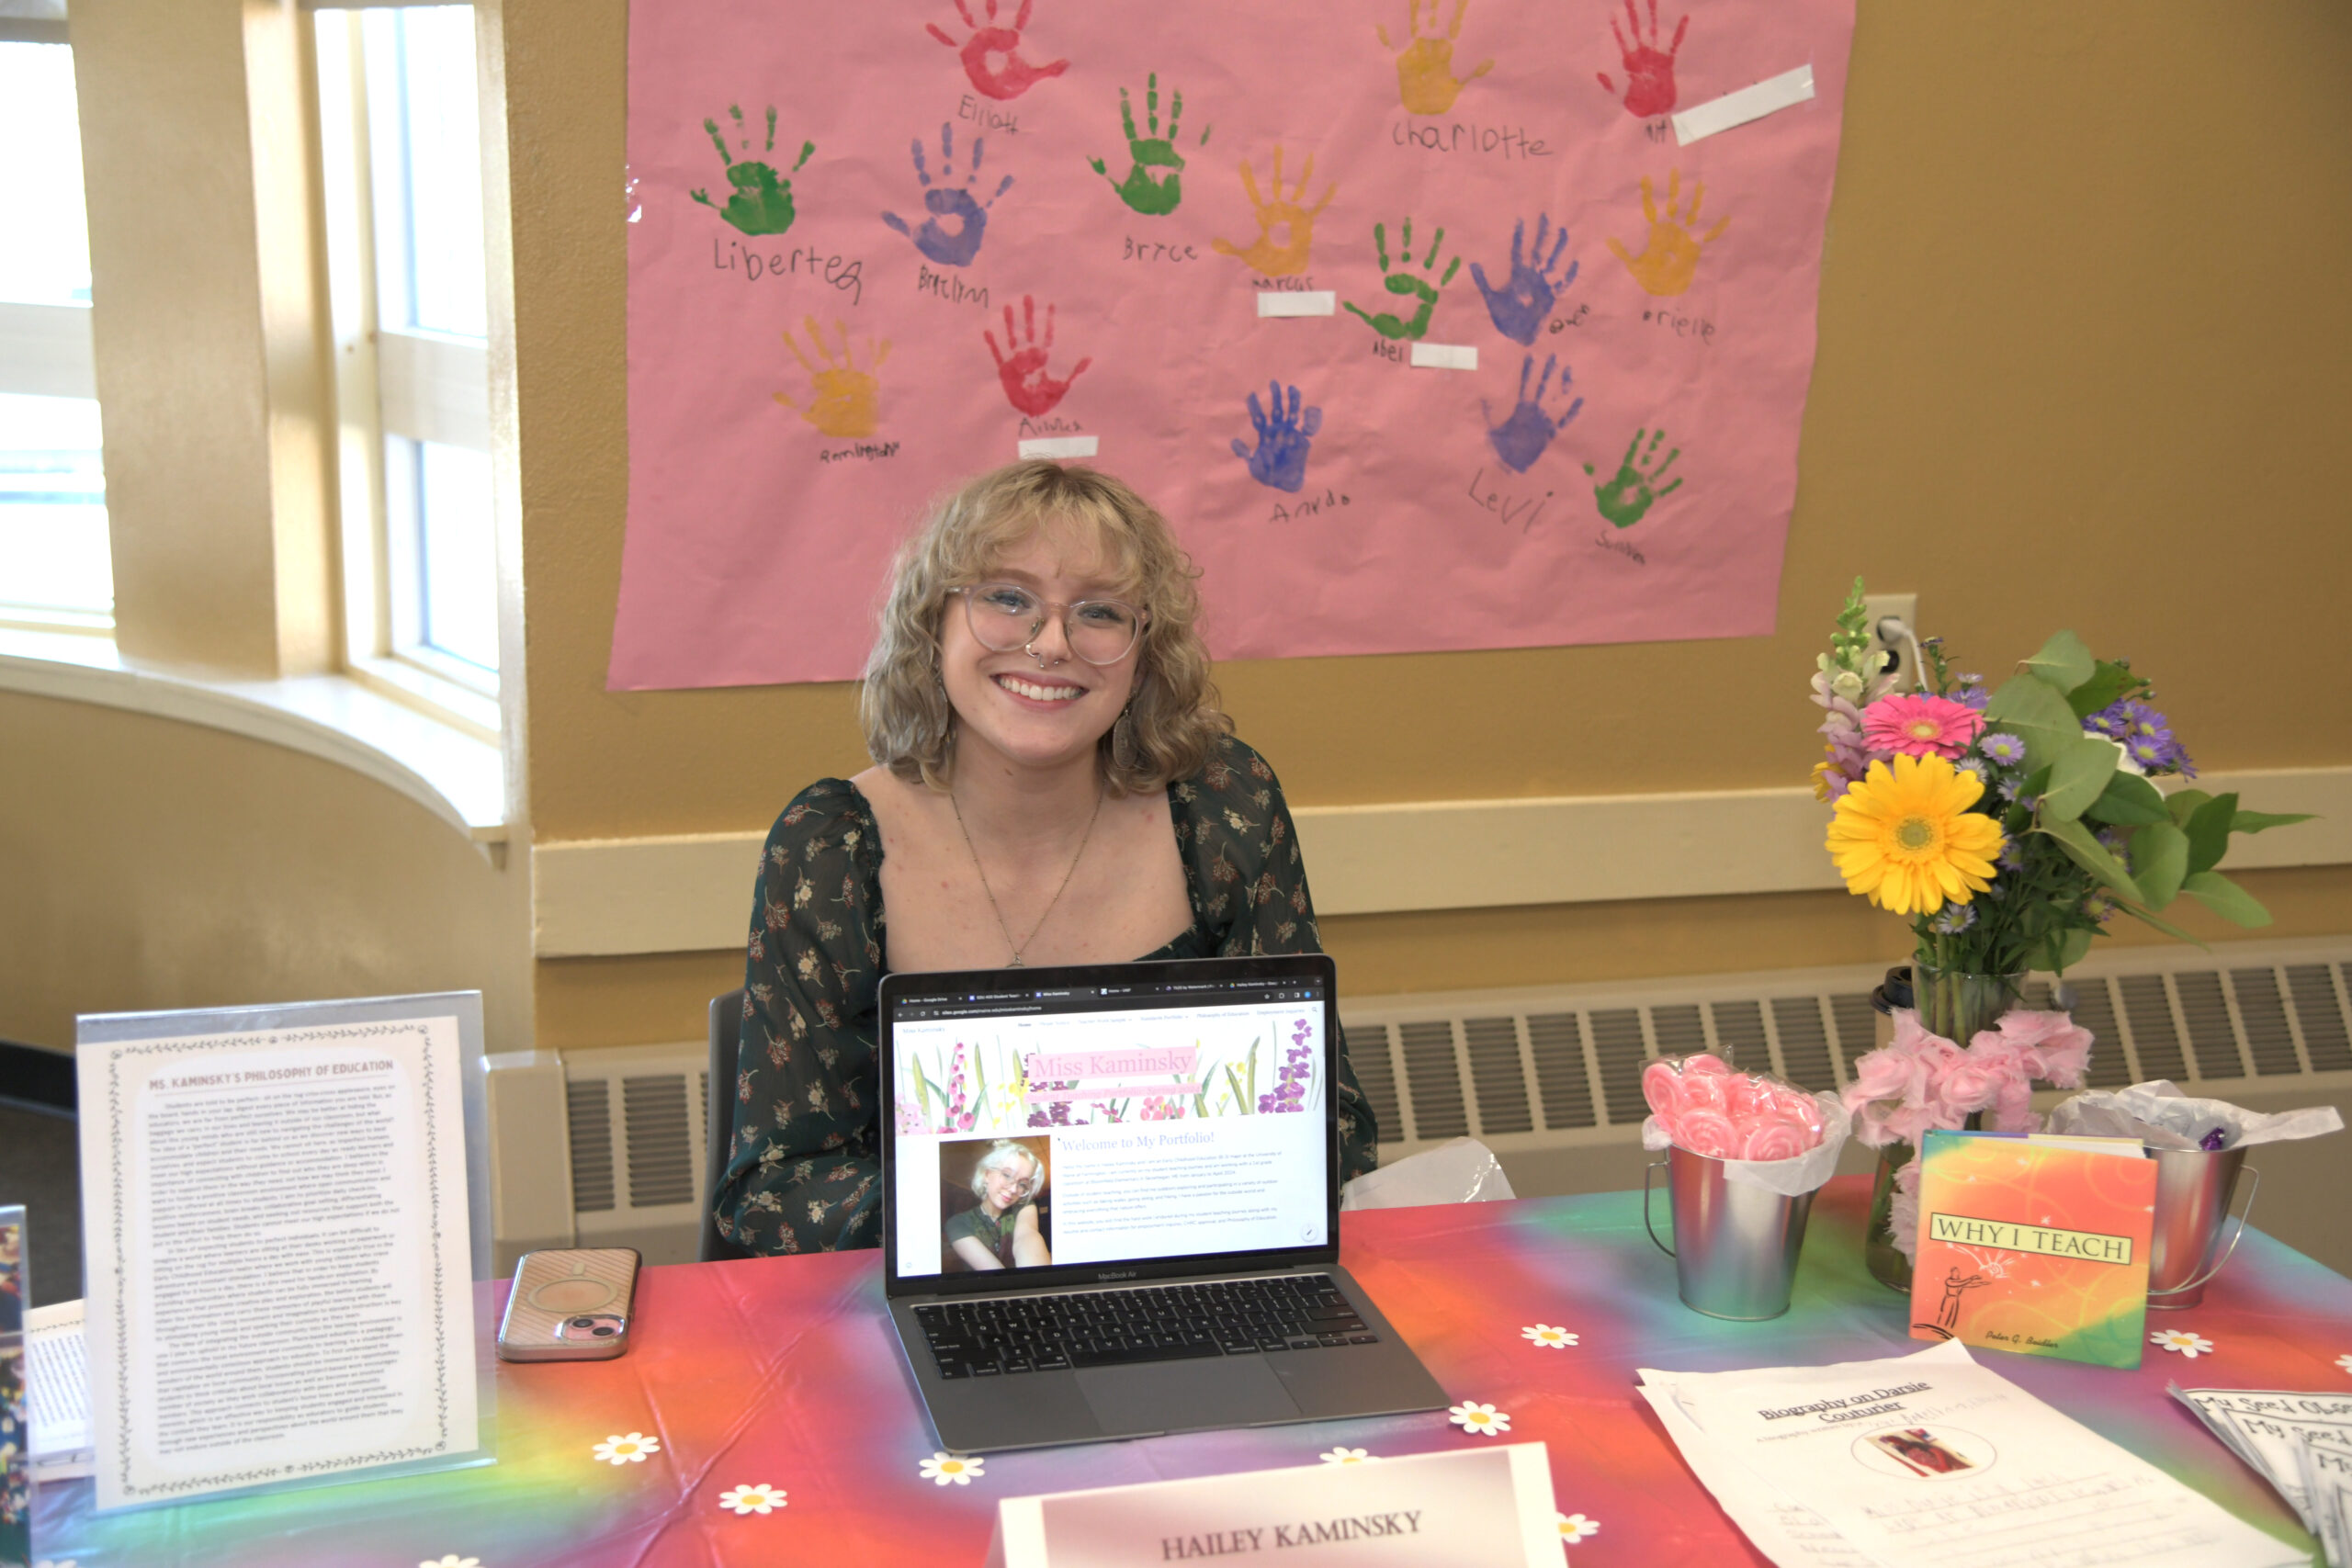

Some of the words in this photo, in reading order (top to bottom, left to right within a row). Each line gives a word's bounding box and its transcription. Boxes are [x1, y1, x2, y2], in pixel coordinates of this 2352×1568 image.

[1392, 121, 1553, 160] Charlotte
[1123, 235, 1199, 263] Bryce
[1468, 468, 1555, 534] Levi
[149, 1078, 167, 1091] MS.
[172, 1072, 241, 1089] KAMINSKY'S
[244, 1066, 311, 1083] PHILOSOPHY
[316, 1065, 329, 1077] OF
[333, 1060, 394, 1075] EDUCATION
[1035, 1057, 1082, 1078] Miss
[1090, 1050, 1193, 1075] Kaminsky
[1062, 1139, 1117, 1152] Welcome
[1121, 1137, 1133, 1148] to
[1136, 1135, 1156, 1150] My
[1159, 1132, 1216, 1145] Portfolio!
[1938, 1218, 2005, 1242] WHY
[2013, 1228, 2019, 1246] I
[2032, 1231, 2123, 1259] TEACH
[1098, 1272, 1125, 1281] MacBook
[1984, 1330, 2009, 1343] Peter
[2011, 1334, 2022, 1344] G.
[1757, 1398, 1849, 1420] Biography
[1849, 1391, 1873, 1404] on
[1872, 1380, 1932, 1401] Darsie
[1817, 1400, 1906, 1424] Couturier
[2194, 1396, 2233, 1412] My
[2238, 1397, 2297, 1415] Seed
[2242, 1418, 2285, 1438] My
[1161, 1529, 1263, 1562] HAILEY
[1274, 1510, 1423, 1549] KAMINSKY
